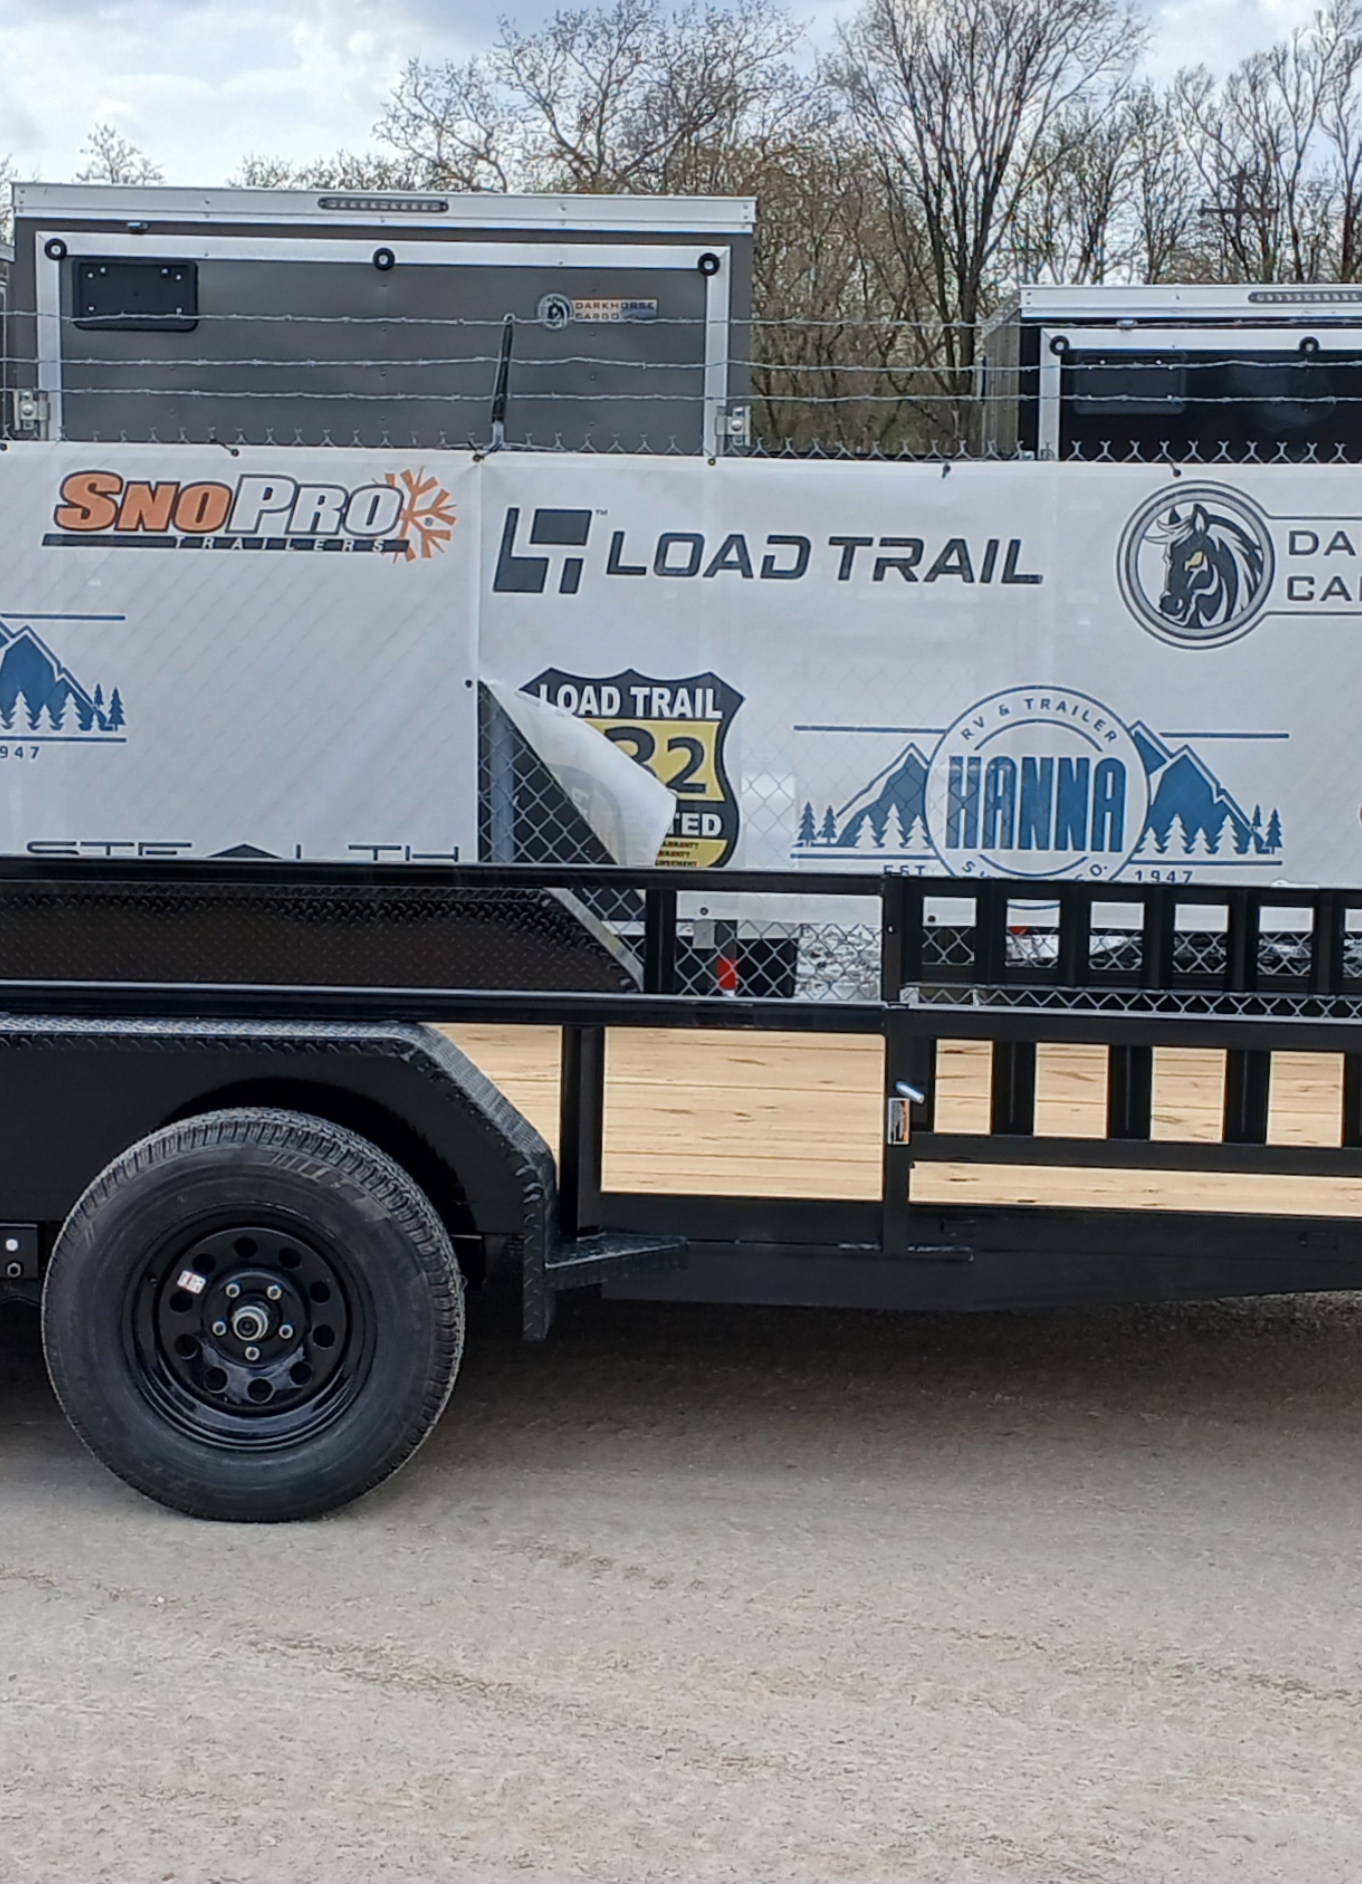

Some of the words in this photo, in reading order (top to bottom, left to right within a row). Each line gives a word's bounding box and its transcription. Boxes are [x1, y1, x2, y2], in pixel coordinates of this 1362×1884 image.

[175, 537, 385, 552] TRAILERS
[606, 531, 812, 580] LOAD
[829, 536, 1044, 585] TRAIL
[630, 687, 723, 719] TRAIL
[960, 716, 985, 741] RV
[998, 704, 1010, 716] &
[1023, 698, 1117, 743] TRAILER
[945, 756, 1126, 853] HANNA
